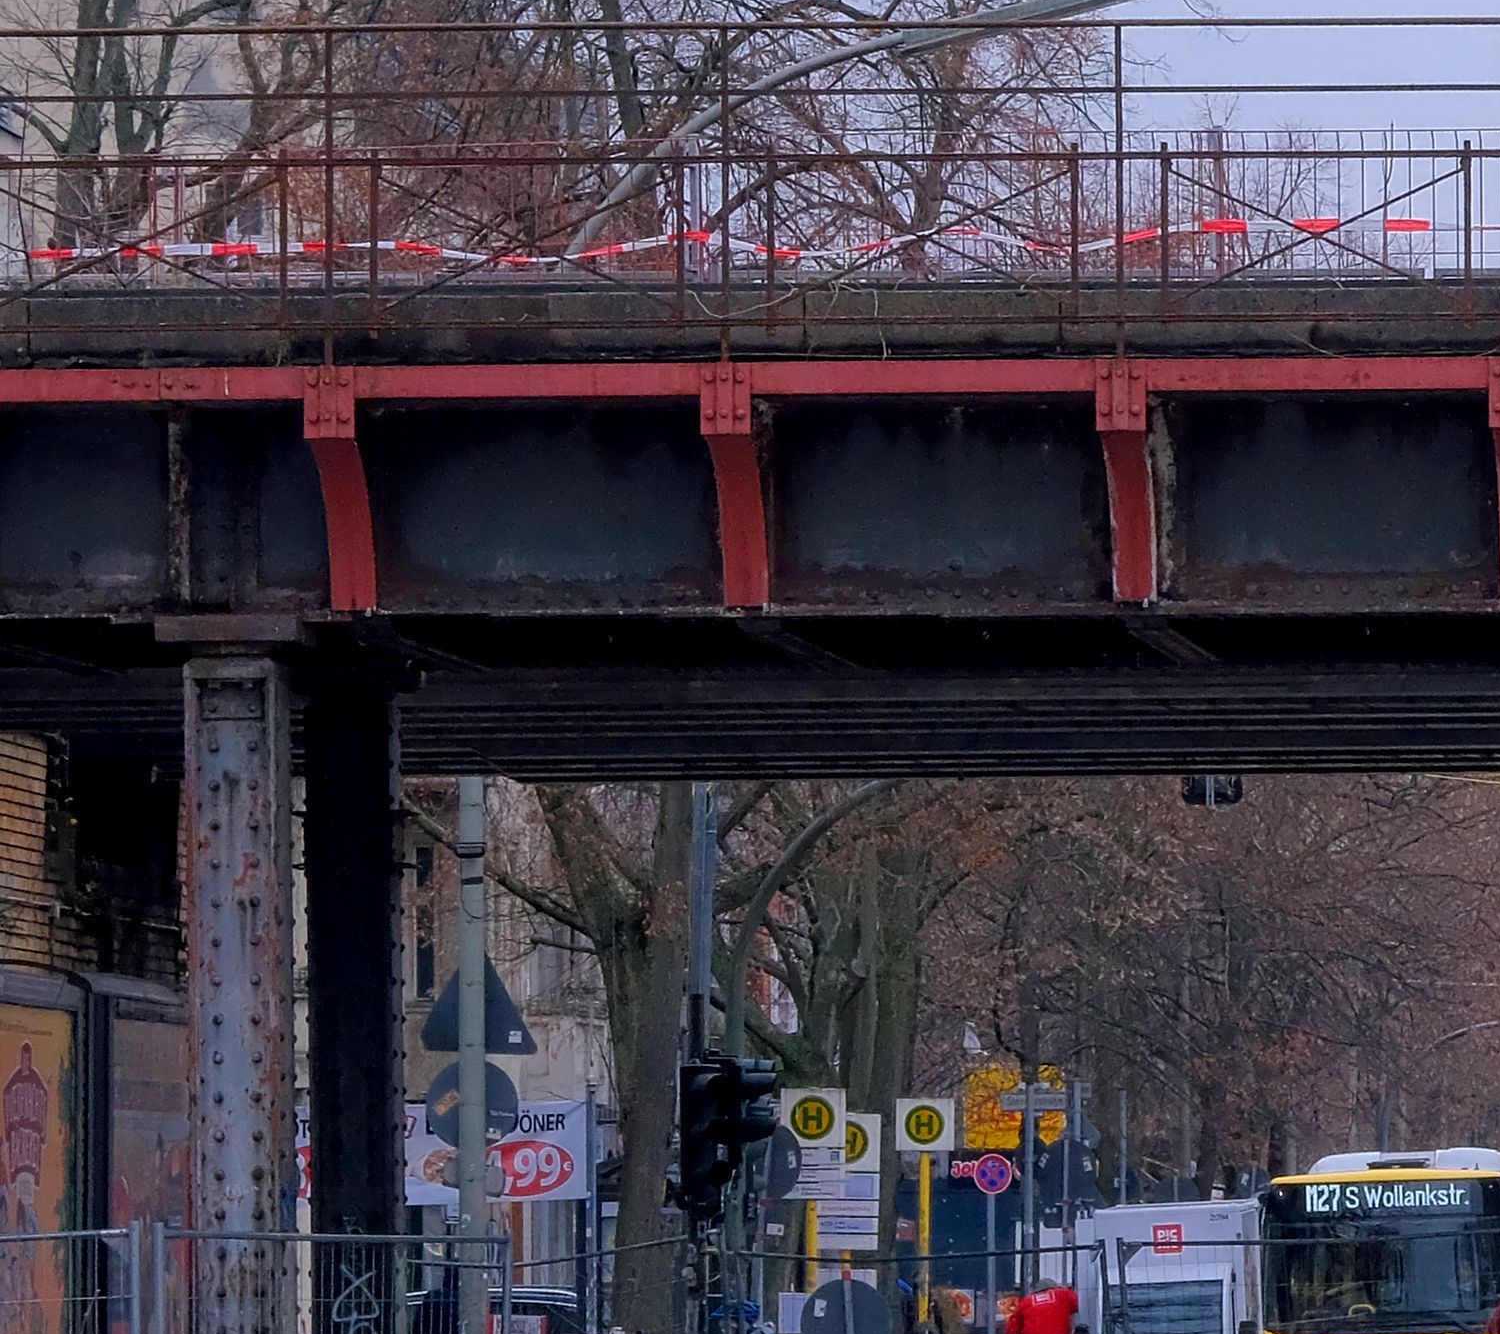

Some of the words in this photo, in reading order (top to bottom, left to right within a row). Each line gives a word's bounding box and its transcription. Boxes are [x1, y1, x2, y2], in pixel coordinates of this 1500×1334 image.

[1305, 1184, 1341, 1212] M27
[1345, 1186, 1359, 1209] S
[1364, 1182, 1470, 1209] Wollankstr.
